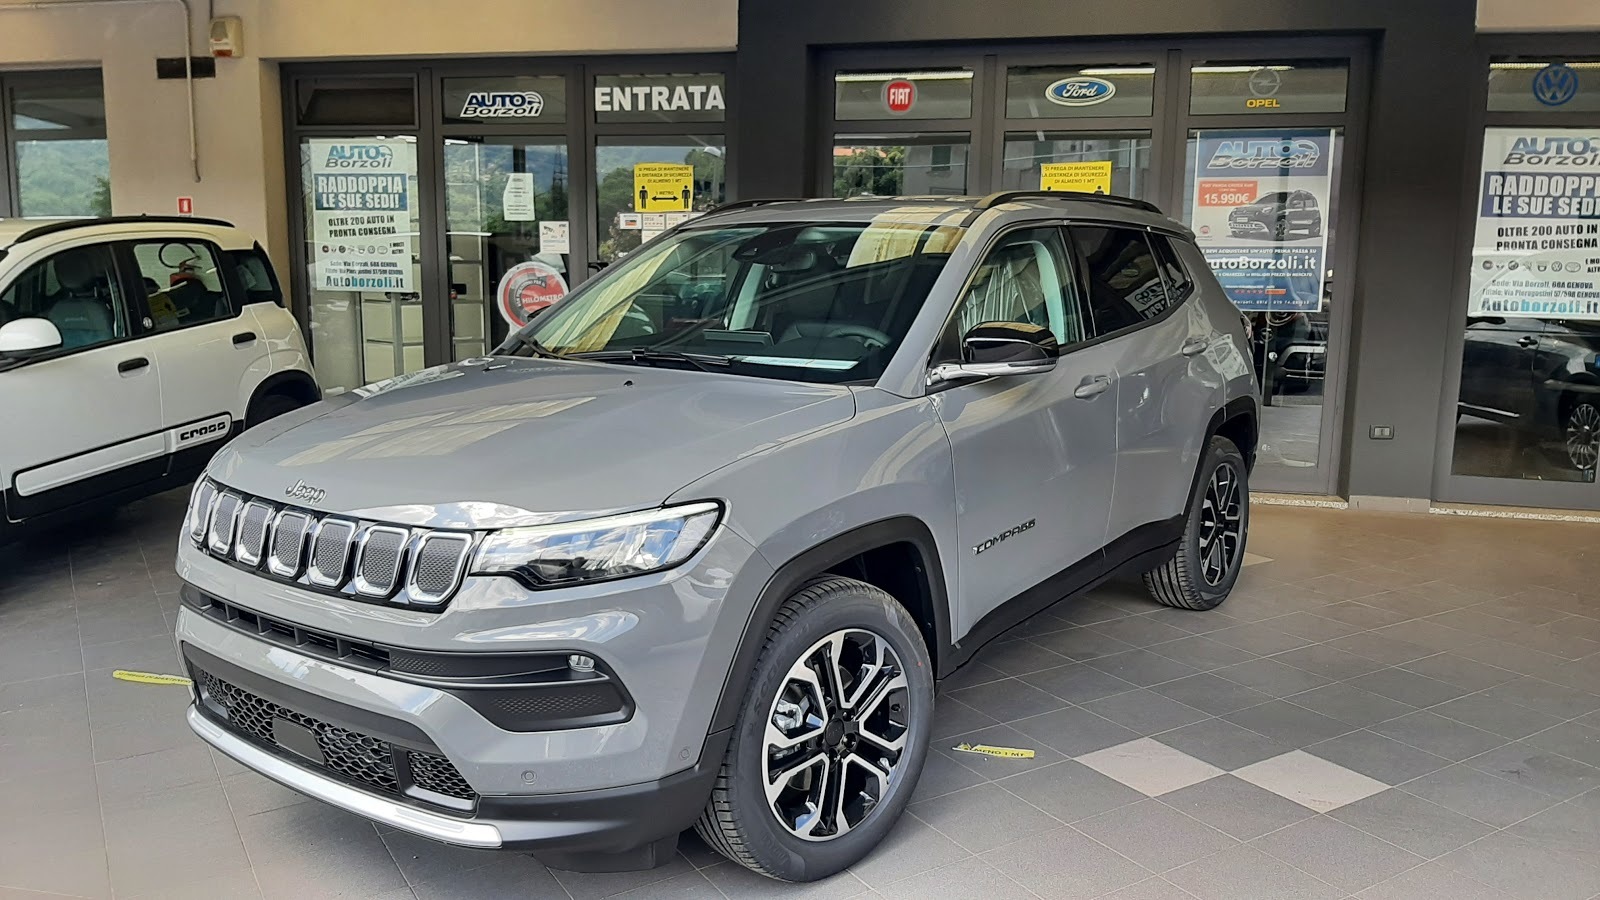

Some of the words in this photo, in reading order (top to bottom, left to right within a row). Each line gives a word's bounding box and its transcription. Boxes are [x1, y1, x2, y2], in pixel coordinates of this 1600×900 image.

[889, 88, 911, 105] FIAT
[1061, 81, 1099, 98] Ford
[467, 94, 526, 107] AUTO
[595, 85, 726, 111] ENTRATA
[1246, 99, 1280, 108] OPEL
[463, 105, 540, 116] Borzoli
[328, 145, 381, 160] AUTO
[1214, 140, 1298, 158] AUTO
[1511, 136, 1591, 155] AUTO
[325, 157, 392, 168] Borzoli
[1207, 153, 1319, 169] Borzoli
[1503, 151, 1600, 166] Borzol
[318, 176, 403, 193] RADDOPPIA
[1488, 175, 1600, 197] RADDOPPI
[322, 193, 336, 208] LE
[338, 193, 363, 208] SUE
[365, 193, 400, 209] SEDI!
[1204, 192, 1250, 204] 15.990€
[1492, 196, 1512, 214] LE
[1517, 197, 1554, 215] SUE
[328, 217, 349, 227] OLTRE
[350, 216, 365, 226] 200
[366, 215, 385, 225] AUTO
[386, 214, 395, 223] IN
[329, 228, 357, 238] PRONTA
[358, 226, 397, 236] CONSEGNA
[1497, 226, 1529, 238] OLTRE
[1531, 225, 1553, 236] 200
[1555, 224, 1583, 235] AUTO
[1586, 223, 1598, 234] IN
[1496, 239, 1538, 251] PRONTA
[1541, 238, 1598, 250] CONSEGNA
[1210, 255, 1316, 270] utoBorzoli.it
[326, 276, 404, 289] Autoborzoli.it
[1566, 281, 1594, 289] GENOVA
[1576, 291, 1600, 299] GENOVA
[1481, 298, 1599, 314] Autoborzoli.it
[285, 479, 327, 506] Jeep
[972, 518, 1036, 556] COMPASS
